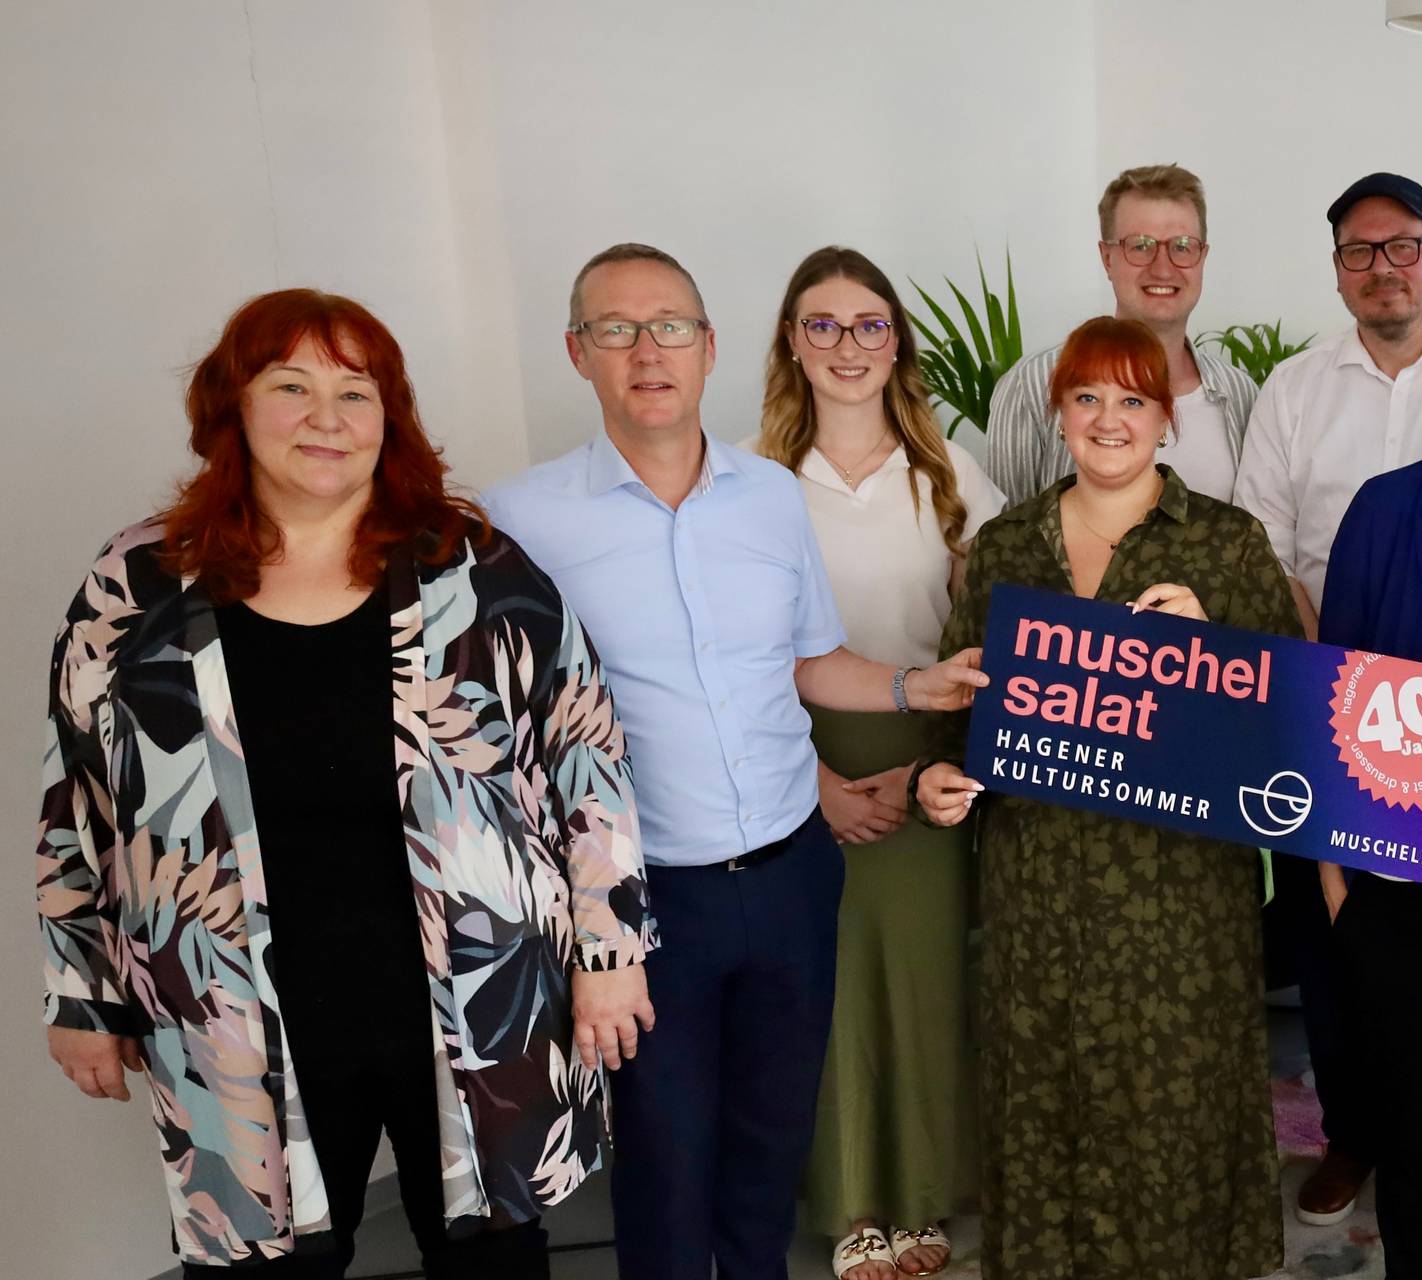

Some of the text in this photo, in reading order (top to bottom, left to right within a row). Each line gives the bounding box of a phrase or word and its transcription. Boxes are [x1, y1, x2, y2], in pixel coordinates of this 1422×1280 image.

[1014, 618, 1271, 703] muschel
[1003, 676, 1158, 741] salat
[1341, 661, 1366, 715] hagener
[996, 728, 1125, 771] HAGENER
[1351, 743, 1398, 790] draussen
[992, 757, 1211, 820] KULTURSOMMER
[1401, 781, 1410, 794] &
